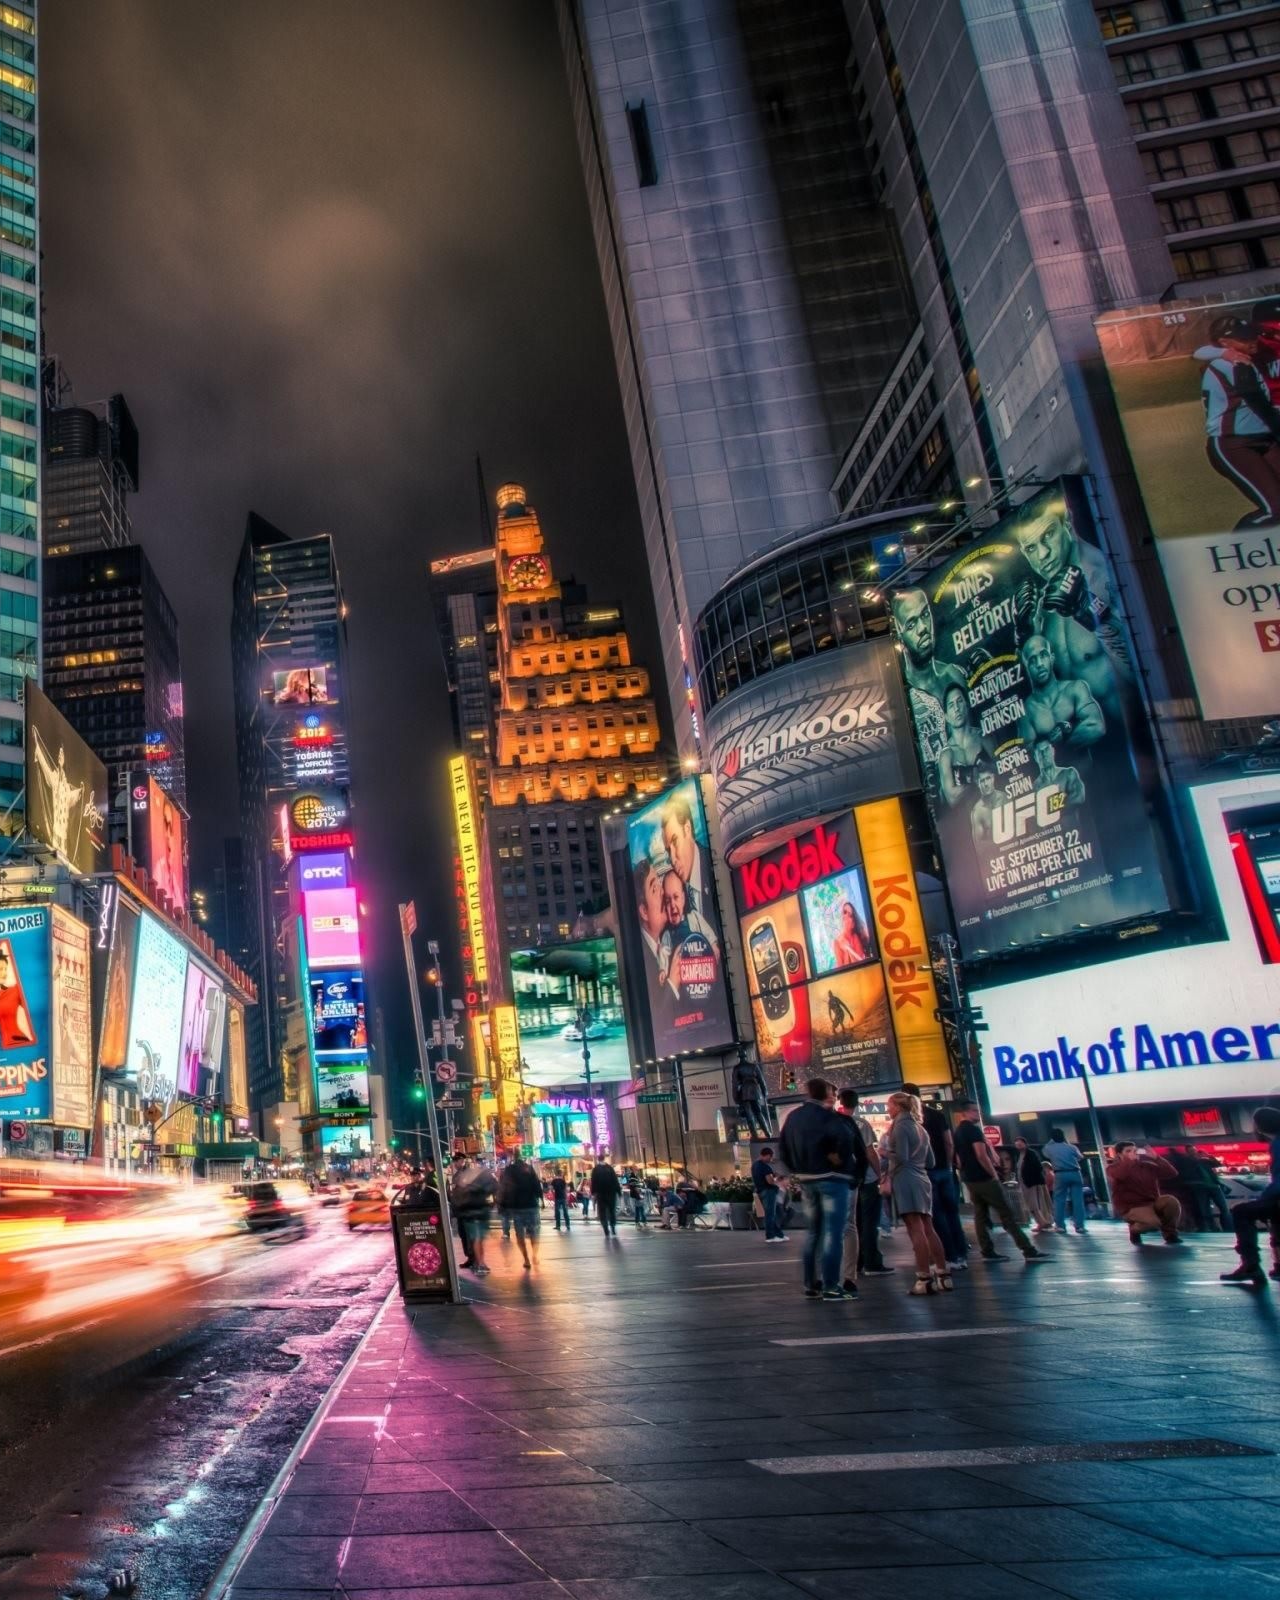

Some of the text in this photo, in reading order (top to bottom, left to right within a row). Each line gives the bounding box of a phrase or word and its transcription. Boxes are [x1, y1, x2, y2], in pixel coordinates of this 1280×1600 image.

[1163, 313, 1187, 326] 215
[953, 566, 994, 609] JONES
[1059, 566, 1080, 594] UFC
[966, 601, 991, 622] VITOR
[952, 598, 1012, 656] BELFORT
[968, 663, 1024, 708] BENAVIDEZ
[980, 699, 1026, 738] JOHNSON
[299, 728, 326, 739] 2012
[295, 752, 334, 762] TOSHIBA
[760, 726, 888, 772] driving emotion
[304, 760, 333, 768] OFFICIAL
[996, 749, 1030, 775] BISPING
[296, 769, 328, 777] SPONSOR
[1004, 775, 1034, 800] STANN
[134, 802, 148, 810] LG
[992, 784, 1062, 845] UFC
[1048, 793, 1067, 812] 152
[306, 817, 339, 829] 2012
[291, 832, 353, 849] TOSHIBA
[453, 765, 486, 938] THE NEW HTC EVO 4G
[989, 856, 1009, 875] SAT.
[1008, 835, 1066, 868] SEPTEMBER
[1065, 829, 1081, 849] 22
[312, 866, 344, 879] TDK
[740, 824, 846, 910] Kodak
[986, 842, 1093, 892] LIVE ON PAY-PER-VIEW
[959, 873, 1115, 928] UFC.COM facebook.com/UFC twitter.com/ufc
[8, 912, 44, 933] MORE!
[686, 940, 705, 953] WILL
[873, 873, 931, 1011] Kodak
[680, 961, 716, 981] CAMPAIGN
[688, 984, 709, 995] ZACH
[322, 1007, 358, 1016] ONLINE
[324, 1001, 355, 1011] ENTER
[674, 1014, 697, 1028] AUGUST
[993, 1035, 1083, 1087] Bank
[1088, 1027, 1127, 1076] of
[690, 1083, 719, 1092] Marriott
